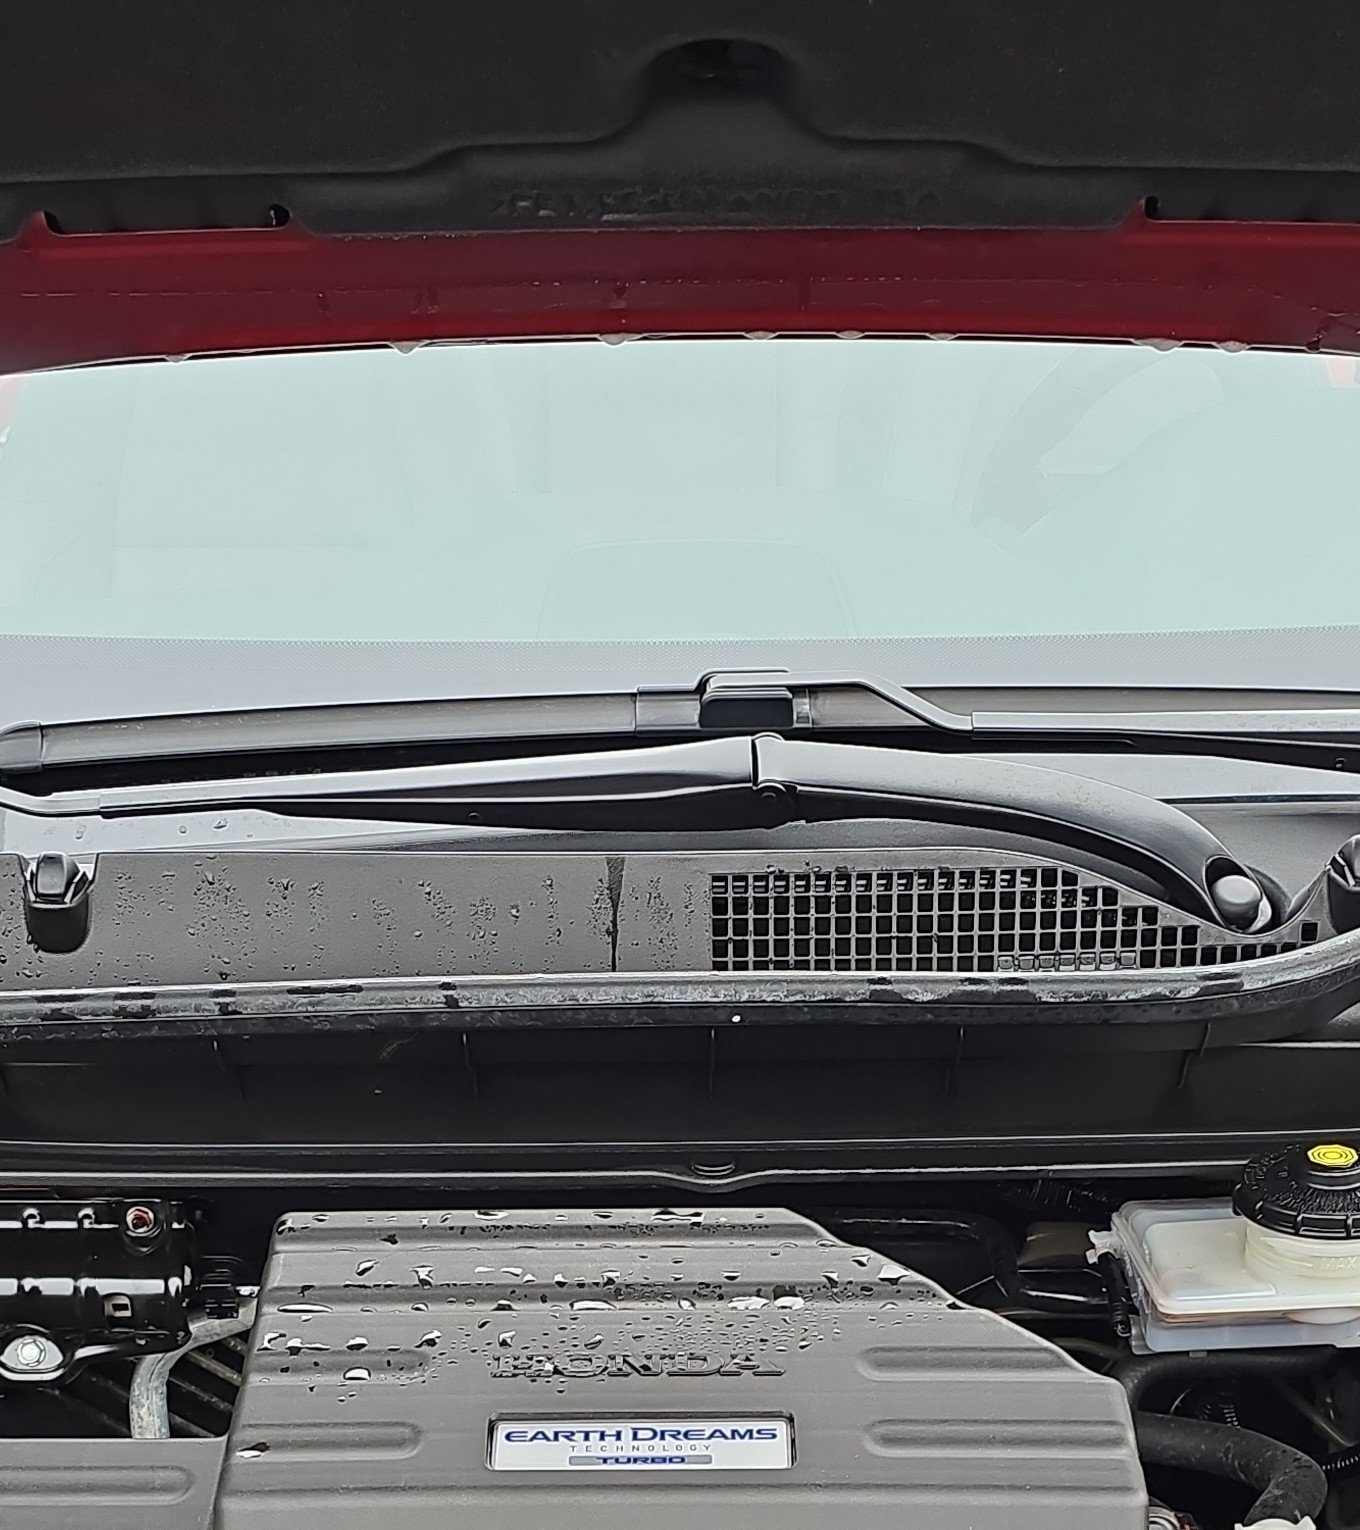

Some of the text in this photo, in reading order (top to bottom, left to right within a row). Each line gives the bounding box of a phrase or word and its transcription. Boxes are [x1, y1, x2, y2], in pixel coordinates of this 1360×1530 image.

[1322, 1257, 1358, 1270] MAX
[491, 1352, 786, 1377] HONDA
[504, 1427, 778, 1443] EARTH DREAMS
[570, 1444, 712, 1453] TECHNOLOGY
[595, 1456, 687, 1466] TURBO
